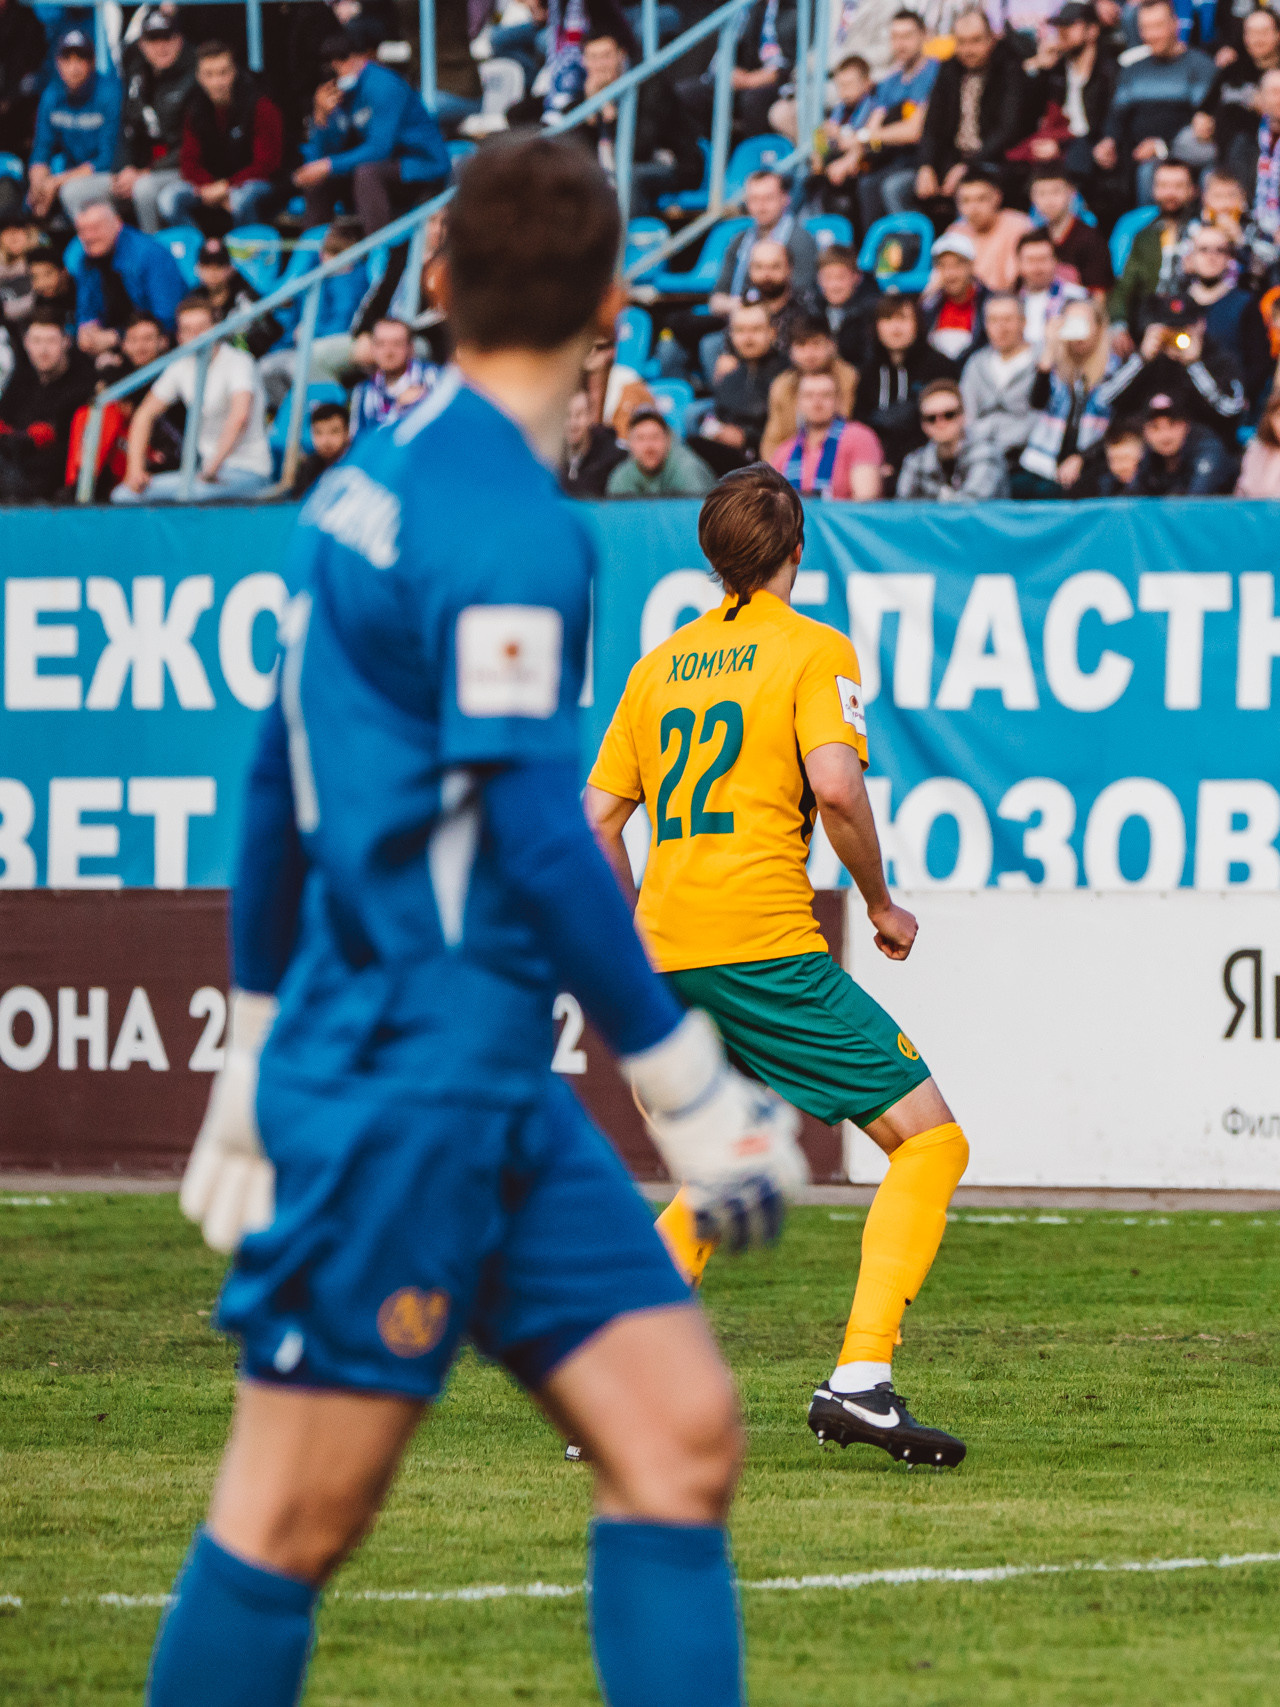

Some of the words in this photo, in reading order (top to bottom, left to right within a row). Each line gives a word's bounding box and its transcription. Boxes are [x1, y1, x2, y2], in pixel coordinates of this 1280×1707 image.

[665, 644, 758, 684] ХОМУХА
[657, 700, 744, 847] 22
[0, 984, 170, 1072] ОНА
